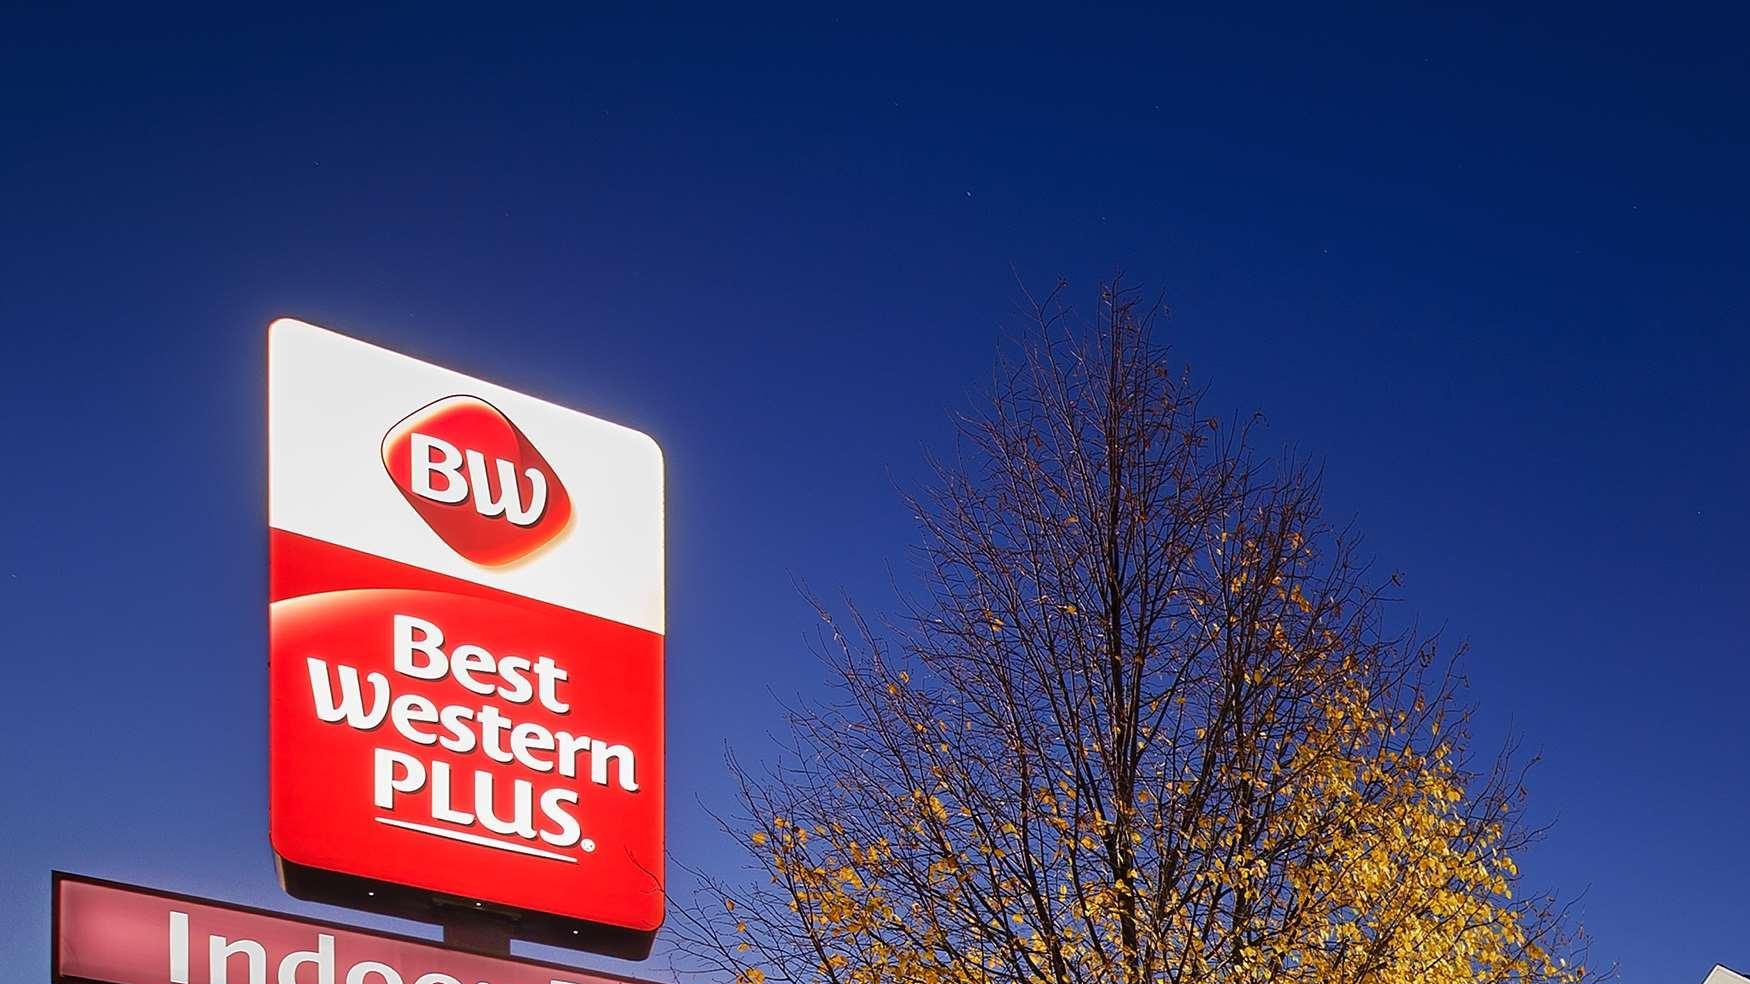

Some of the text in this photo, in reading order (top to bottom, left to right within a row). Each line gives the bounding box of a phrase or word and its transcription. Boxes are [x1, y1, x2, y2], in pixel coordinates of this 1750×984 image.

[411, 432, 547, 526] BW
[394, 614, 570, 714] Best
[307, 656, 639, 792] Western
